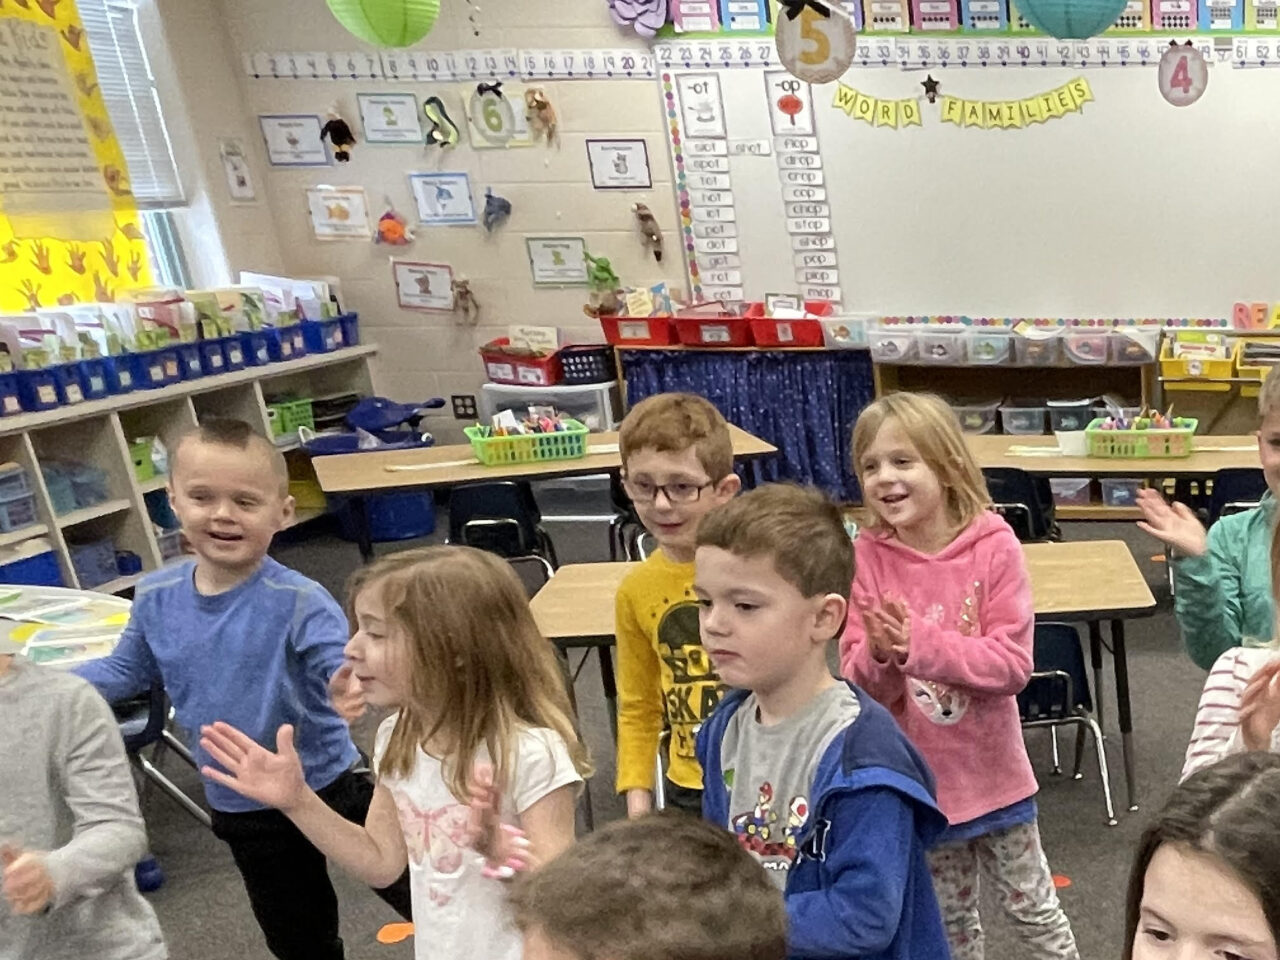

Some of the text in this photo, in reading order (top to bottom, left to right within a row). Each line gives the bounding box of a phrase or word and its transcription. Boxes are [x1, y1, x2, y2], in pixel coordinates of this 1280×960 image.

[799, 1, 830, 65] 5
[524, 56, 536, 70] 15
[544, 57, 556, 70] 16
[564, 56, 574, 69] 17
[583, 56, 595, 70] 18
[603, 56, 615, 69] 19
[621, 57, 635, 69] 20
[641, 57, 653, 70] 21
[660, 46, 770, 60] 22 23 24 25 26 27
[858, 46, 1150, 60] 32 33 34 35 36 37 38 39 40 41 42 43 44 45 46
[1170, 56, 1193, 93] 4
[484, 98, 502, 132] 6
[838, 76, 1085, 121] WORD FAMILIES
